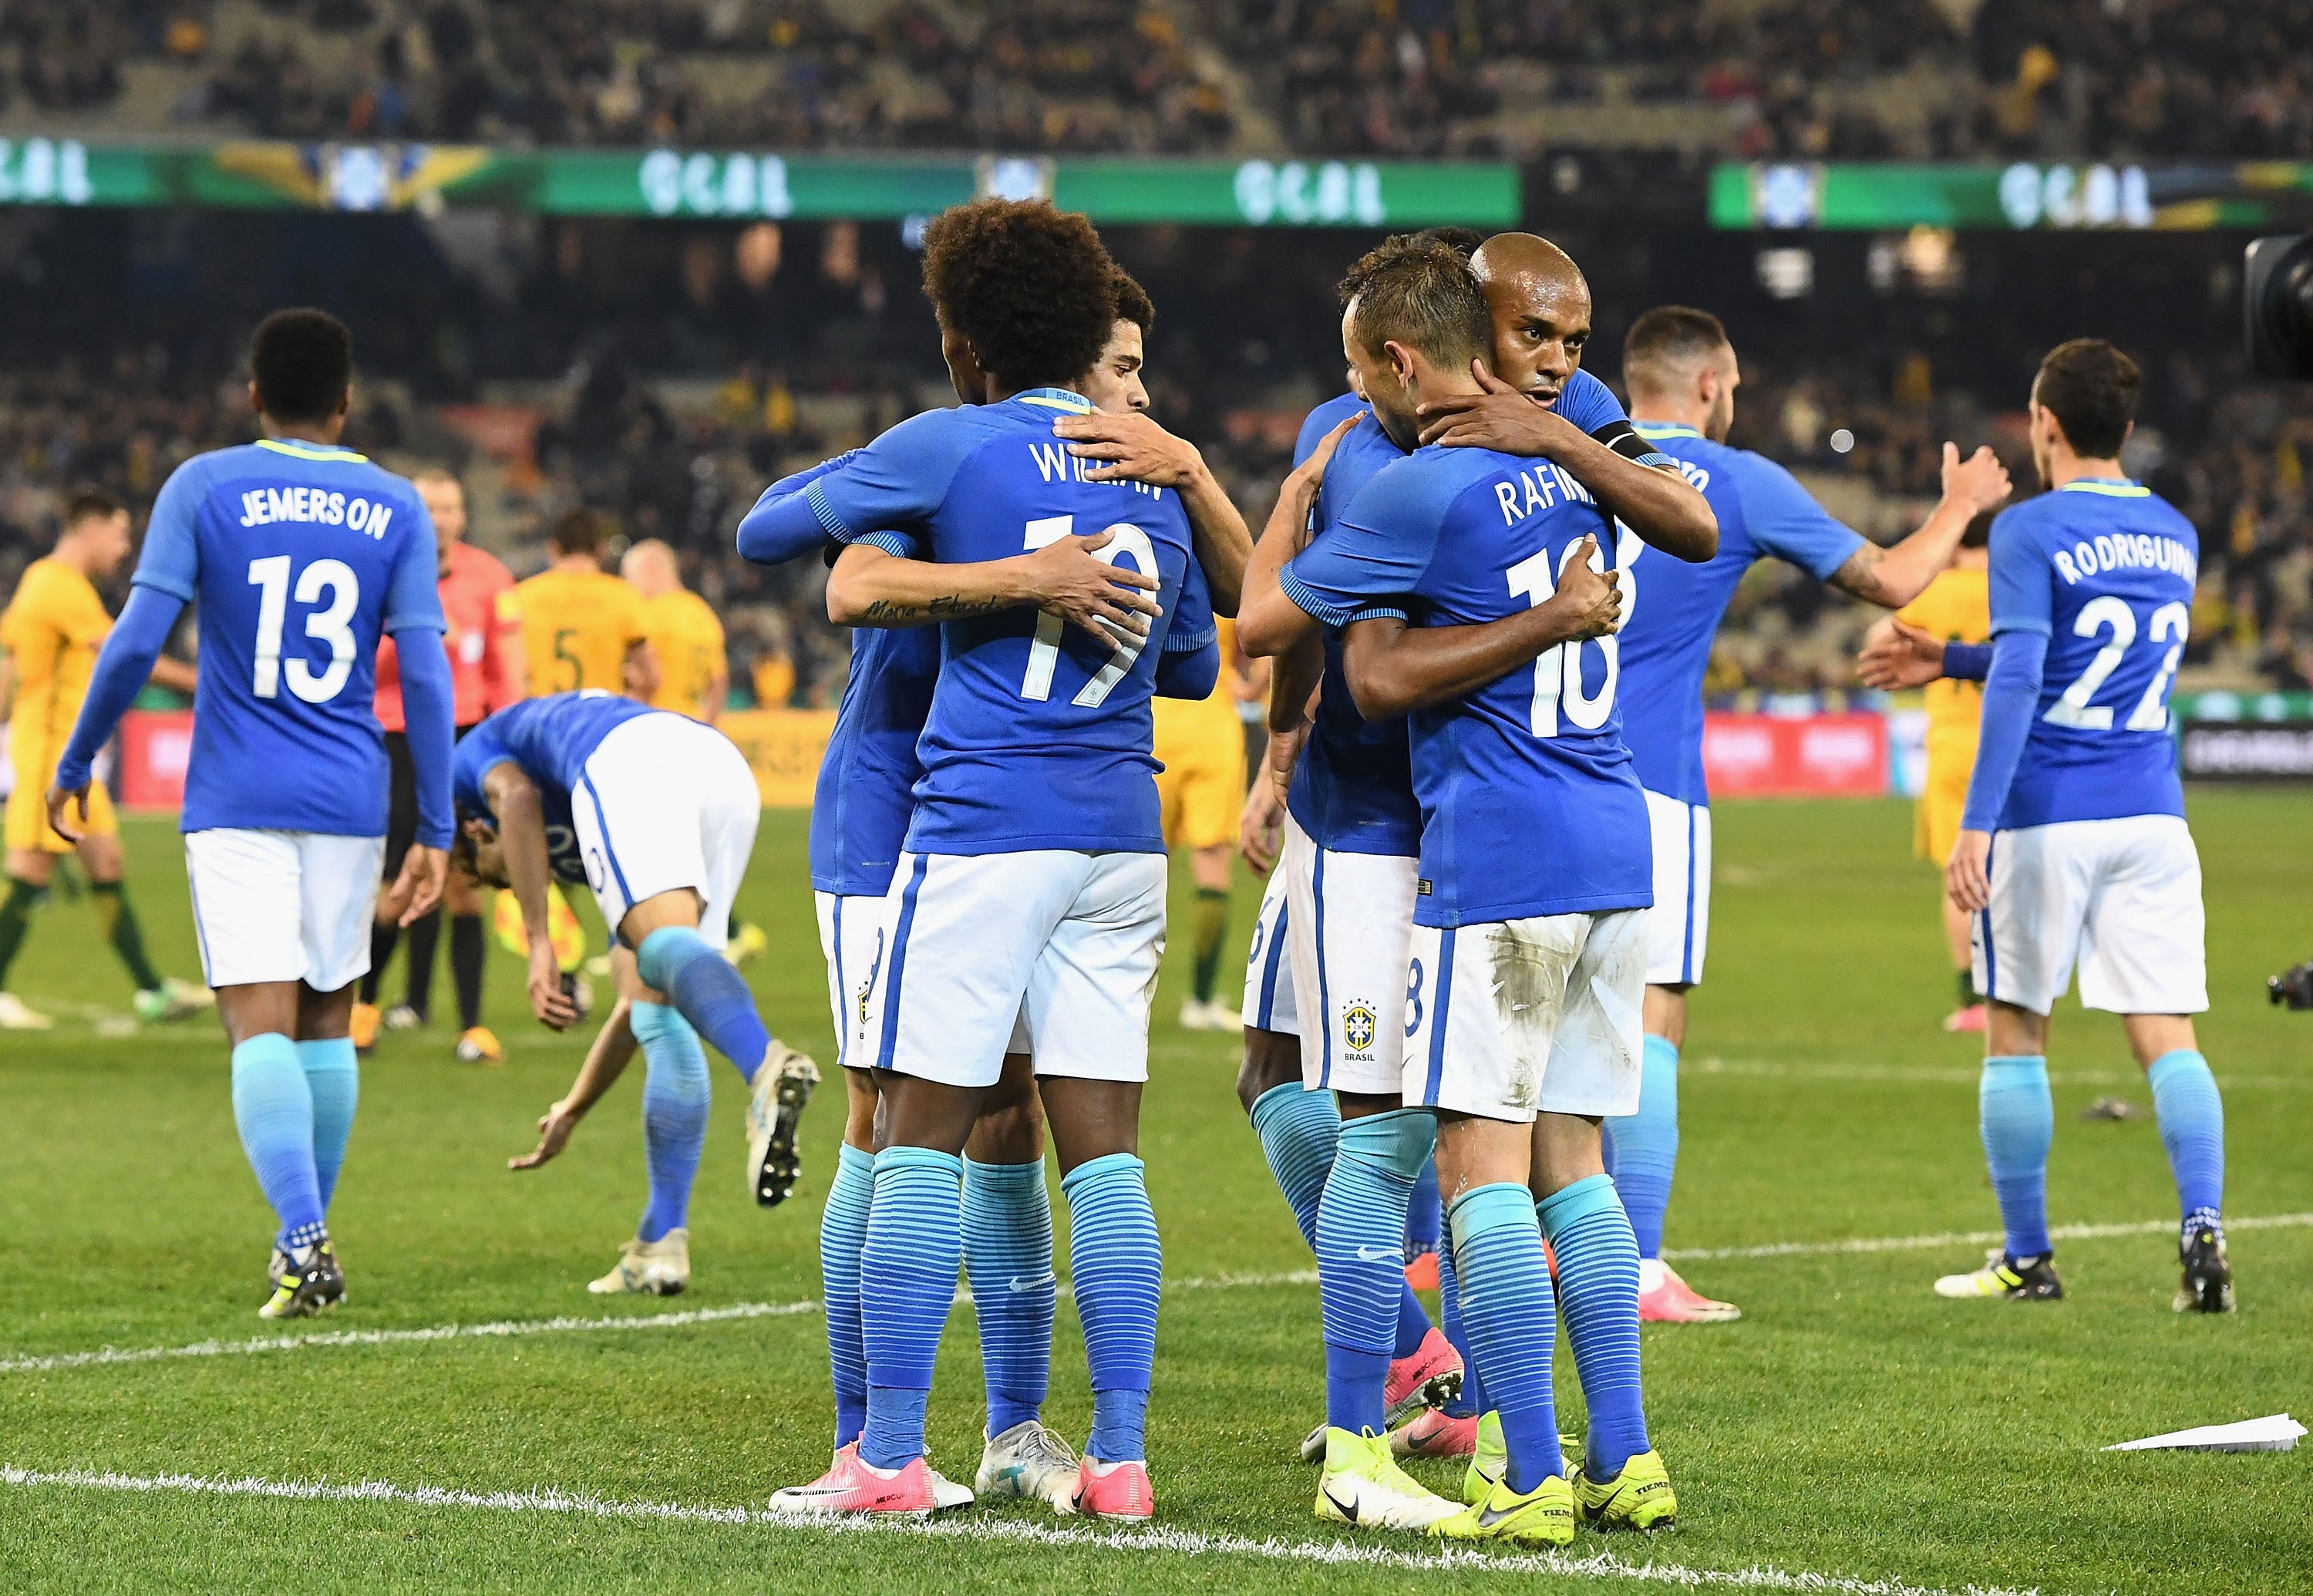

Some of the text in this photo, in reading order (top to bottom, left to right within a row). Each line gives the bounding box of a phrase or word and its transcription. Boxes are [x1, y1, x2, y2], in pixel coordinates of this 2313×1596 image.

[1056, 392, 1084, 406] BRASIL
[240, 487, 392, 540] JEMERSON
[1494, 463, 1598, 527] RAFIN
[247, 555, 359, 703] 13
[1021, 515, 1160, 709] 19
[554, 628, 584, 692] 5
[2043, 596, 2190, 731] 22
[1344, 1053, 1375, 1062] BRASIL
